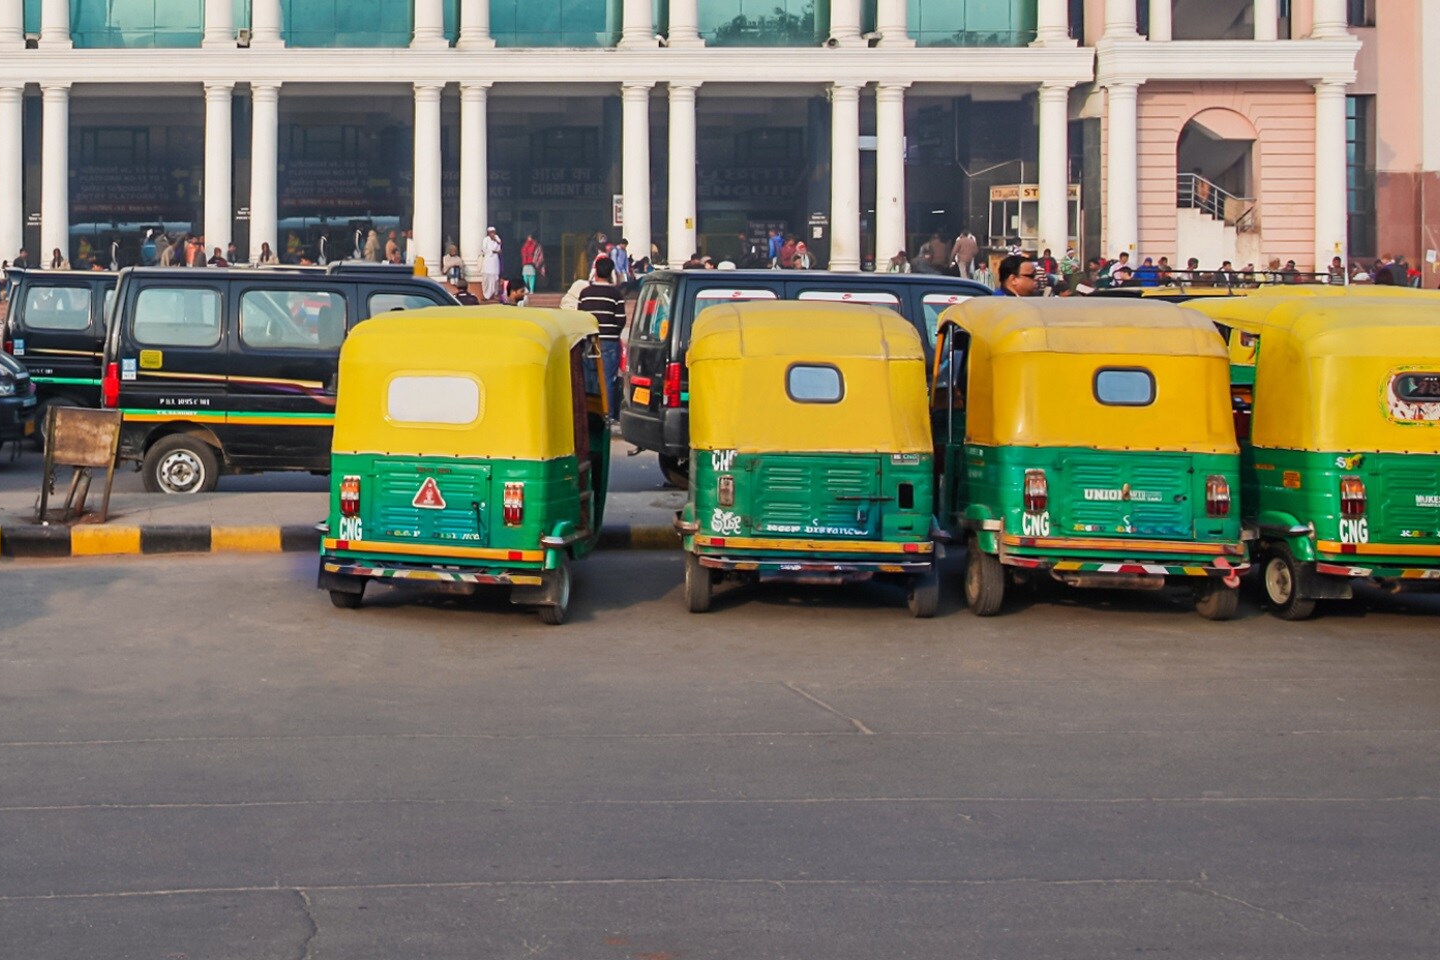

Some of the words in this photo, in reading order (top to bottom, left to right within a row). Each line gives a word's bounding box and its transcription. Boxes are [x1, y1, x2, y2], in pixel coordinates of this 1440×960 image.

[531, 183, 581, 195] CURRENT
[339, 517, 363, 540] CNG
[1022, 511, 1050, 536] CNG
[1339, 518, 1369, 543] CNG
